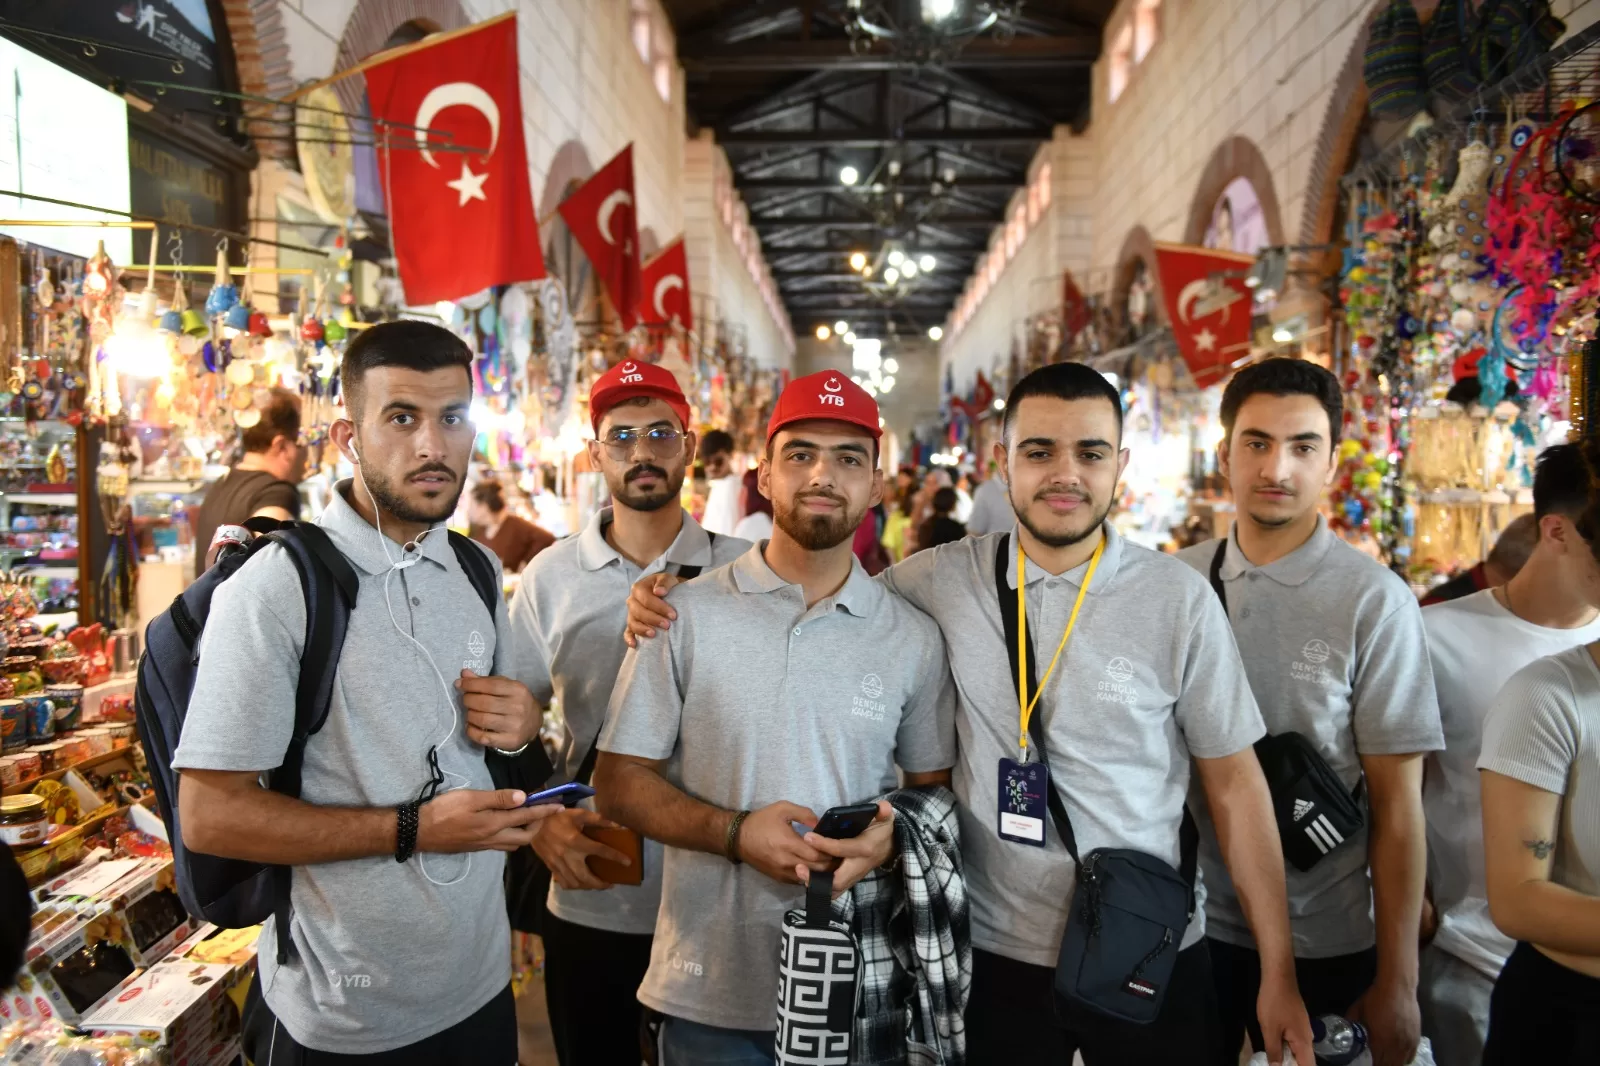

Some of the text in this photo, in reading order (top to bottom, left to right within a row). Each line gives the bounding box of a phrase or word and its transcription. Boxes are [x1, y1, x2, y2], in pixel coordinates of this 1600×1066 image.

[619, 373, 644, 384] YTB
[818, 393, 845, 407] YTB
[683, 959, 704, 976] YTB
[344, 974, 372, 988] YTB
